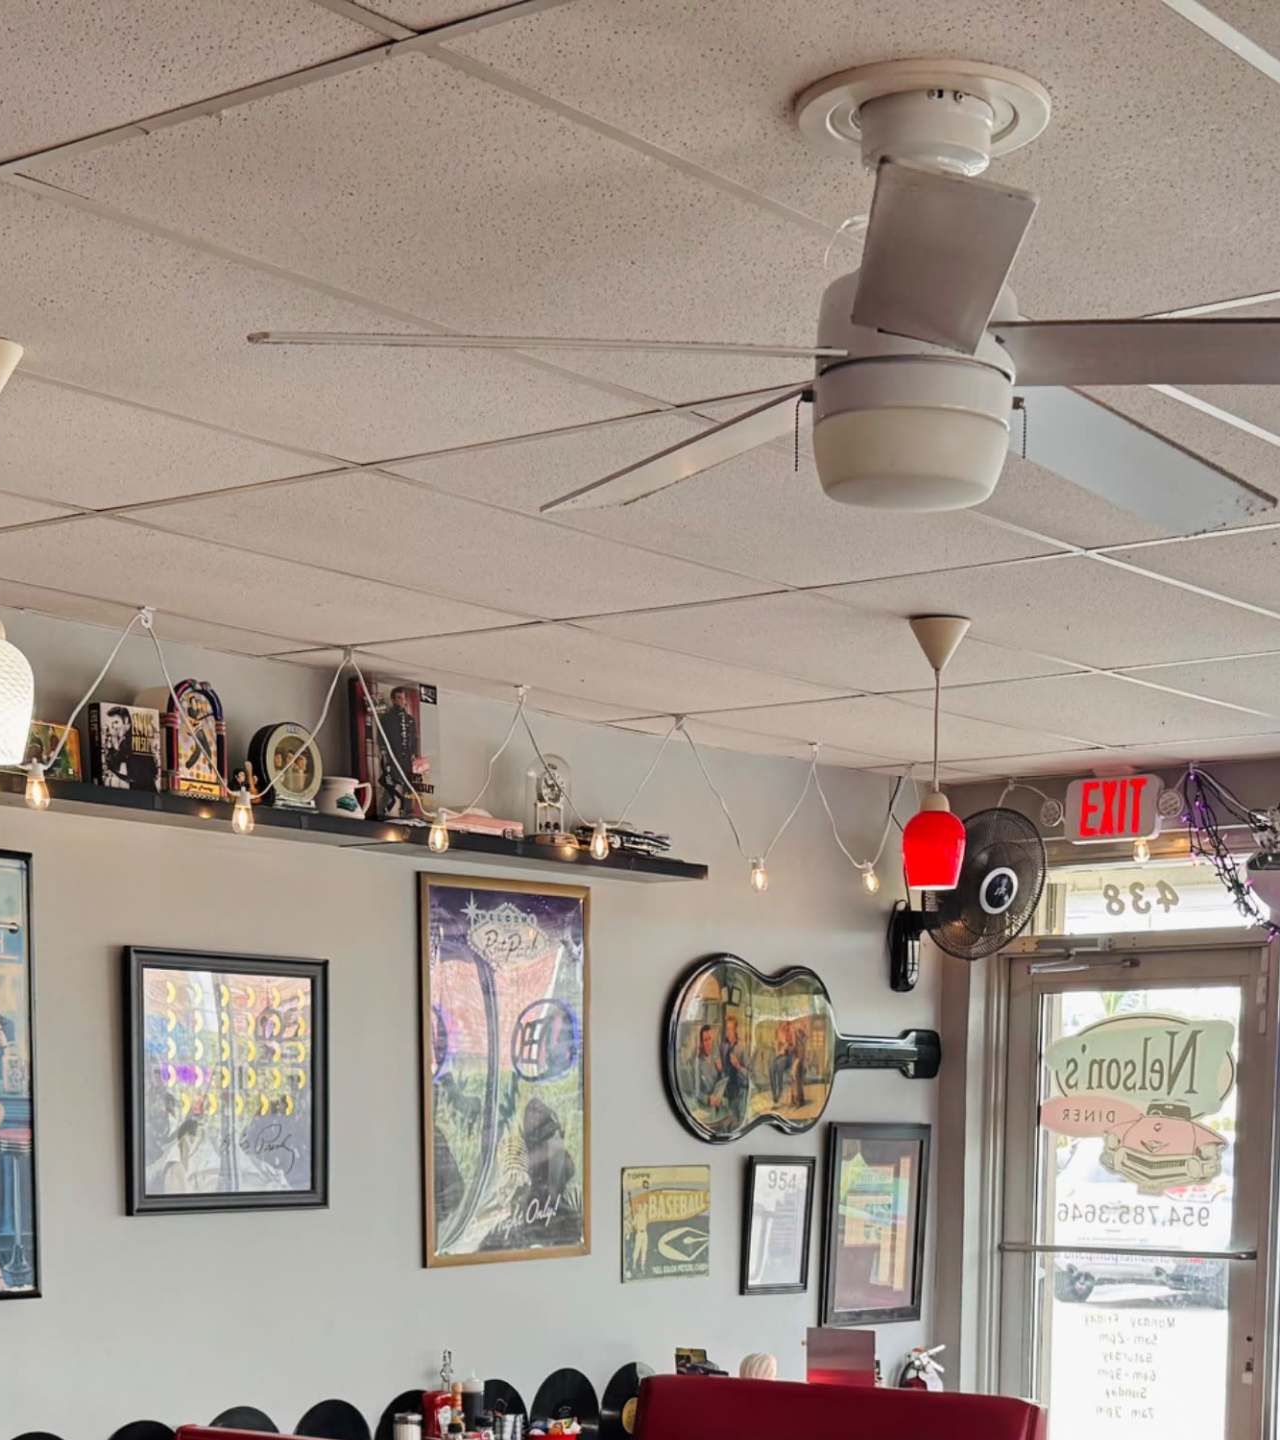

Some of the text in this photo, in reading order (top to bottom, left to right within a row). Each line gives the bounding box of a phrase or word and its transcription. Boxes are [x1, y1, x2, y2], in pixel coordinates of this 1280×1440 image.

[1080, 777, 1146, 837] EXIT
[526, 1193, 561, 1228] Only!
[648, 1192, 706, 1217] BASEBALL
